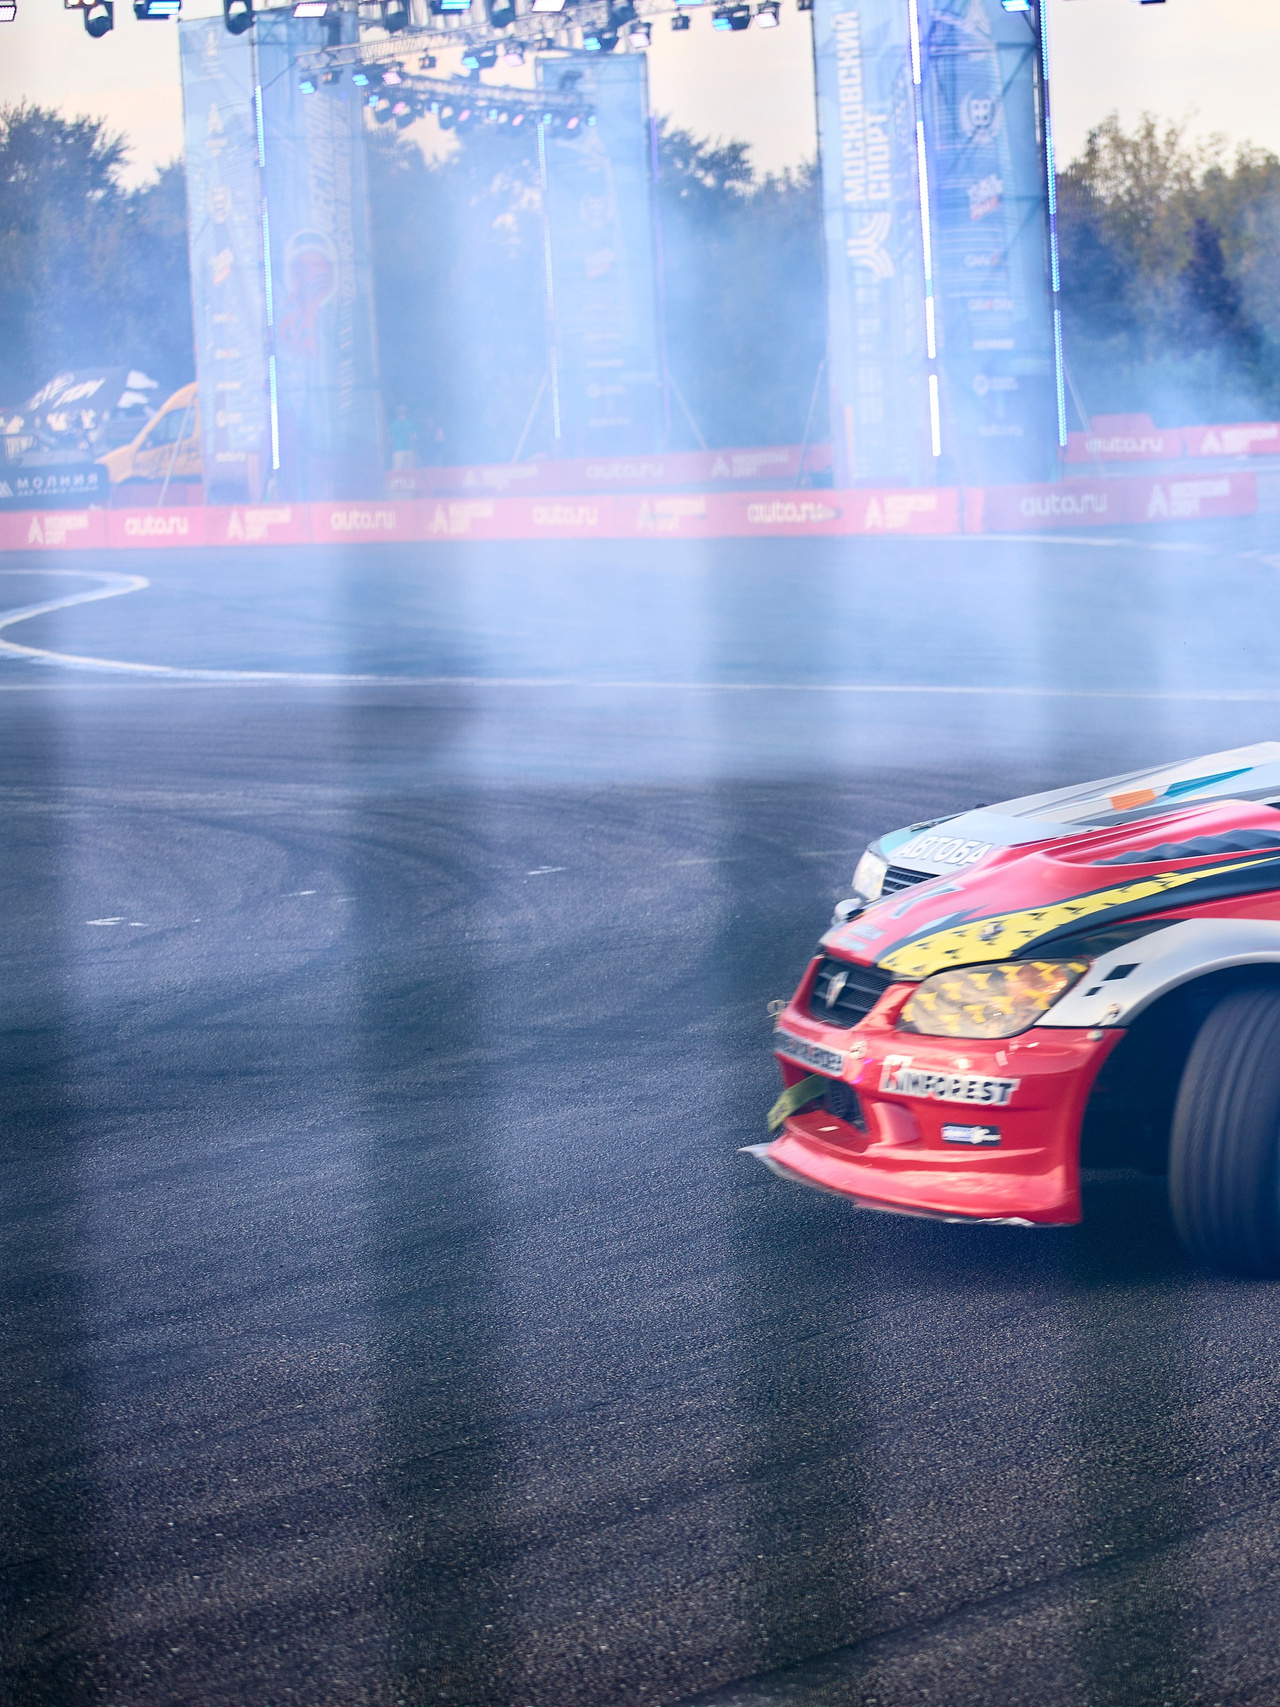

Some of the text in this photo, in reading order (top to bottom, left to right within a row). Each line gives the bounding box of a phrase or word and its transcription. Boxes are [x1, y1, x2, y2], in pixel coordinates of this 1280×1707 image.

[831, 11, 866, 202] МОСКОВСКИЙ
[866, 111, 892, 201] СПОРТ
[879, 1054, 1020, 1106] KINFOREST
